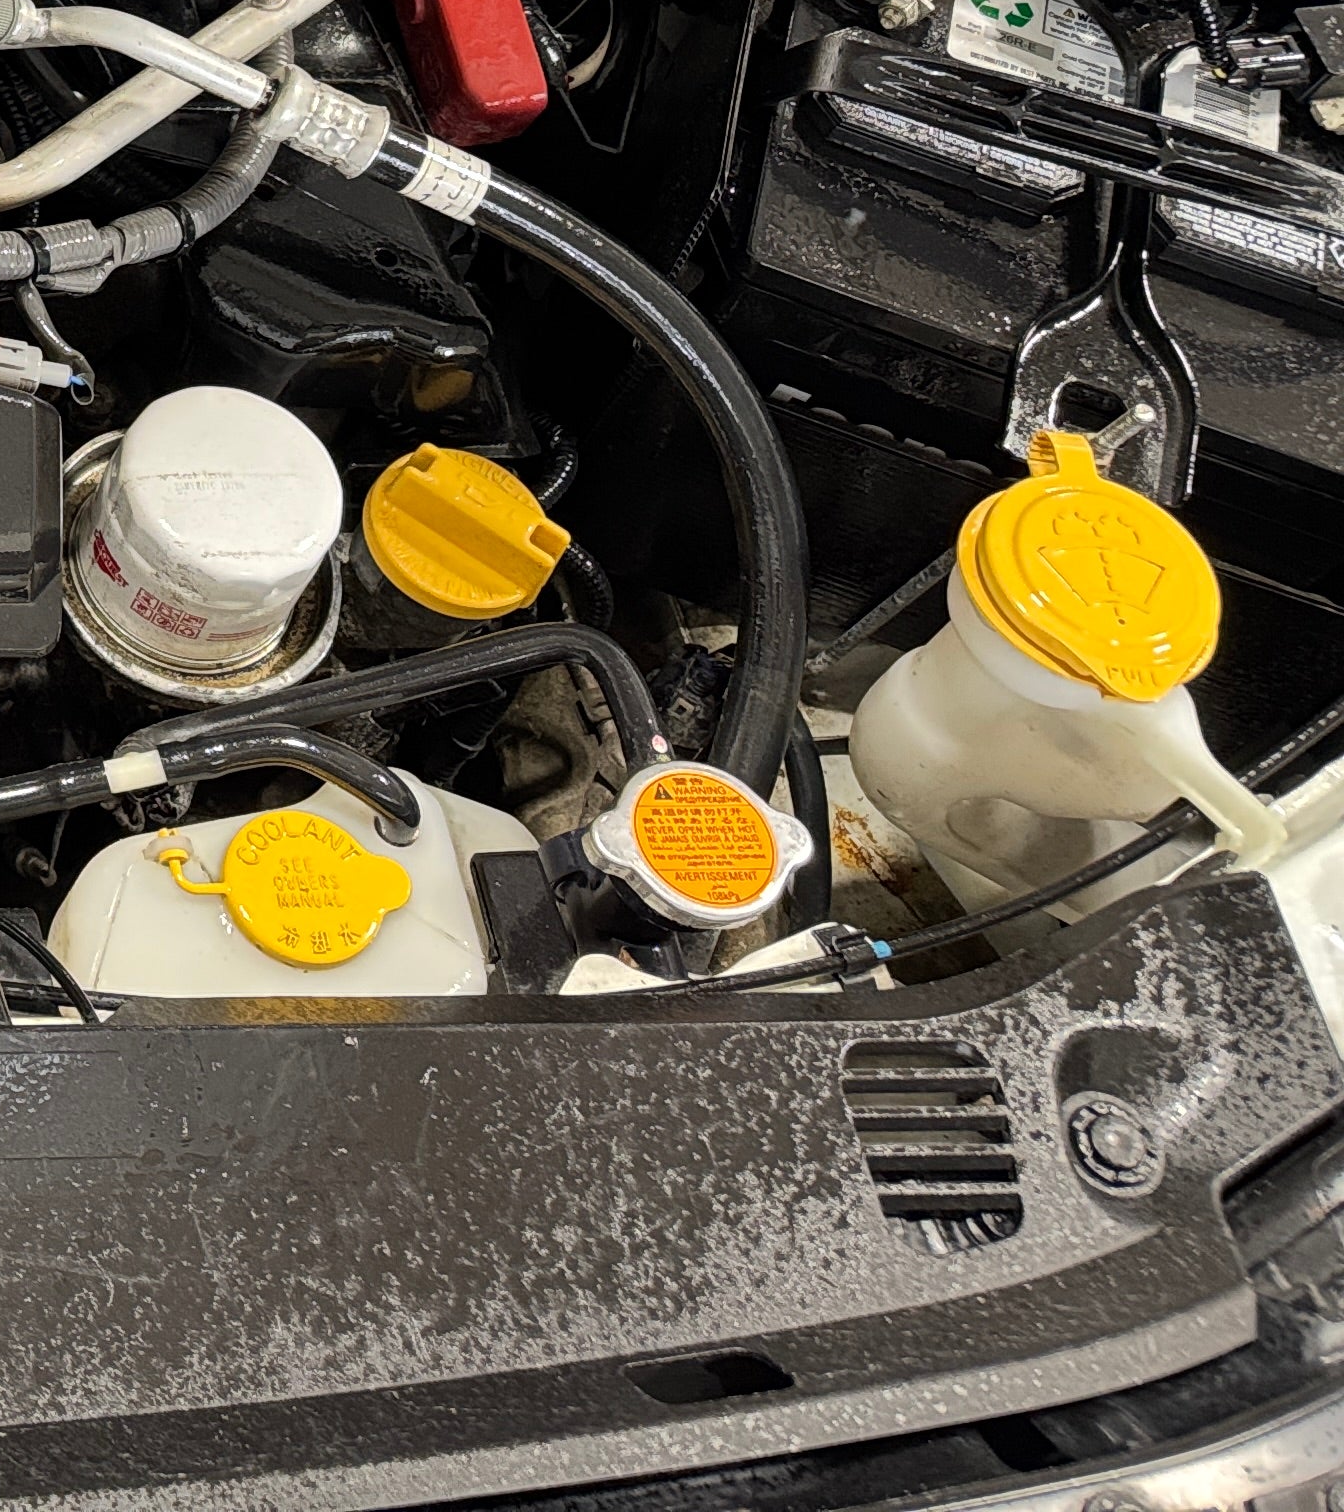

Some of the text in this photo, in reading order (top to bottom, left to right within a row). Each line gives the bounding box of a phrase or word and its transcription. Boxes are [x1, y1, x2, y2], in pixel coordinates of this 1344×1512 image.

[1105, 666, 1159, 688] PULL
[672, 786, 727, 795] WARNING
[644, 825, 674, 834] NEVER
[678, 825, 703, 834] OPEN
[706, 825, 735, 834] WHEN
[236, 816, 362, 866] COOLANT
[661, 835, 689, 843] JAMAIS
[691, 835, 723, 843] OUVRIR
[732, 834, 760, 843] CHAUD
[279, 856, 312, 874] SEE
[675, 871, 758, 882] AVERTISSEMENT
[276, 893, 345, 909] MANUAL
